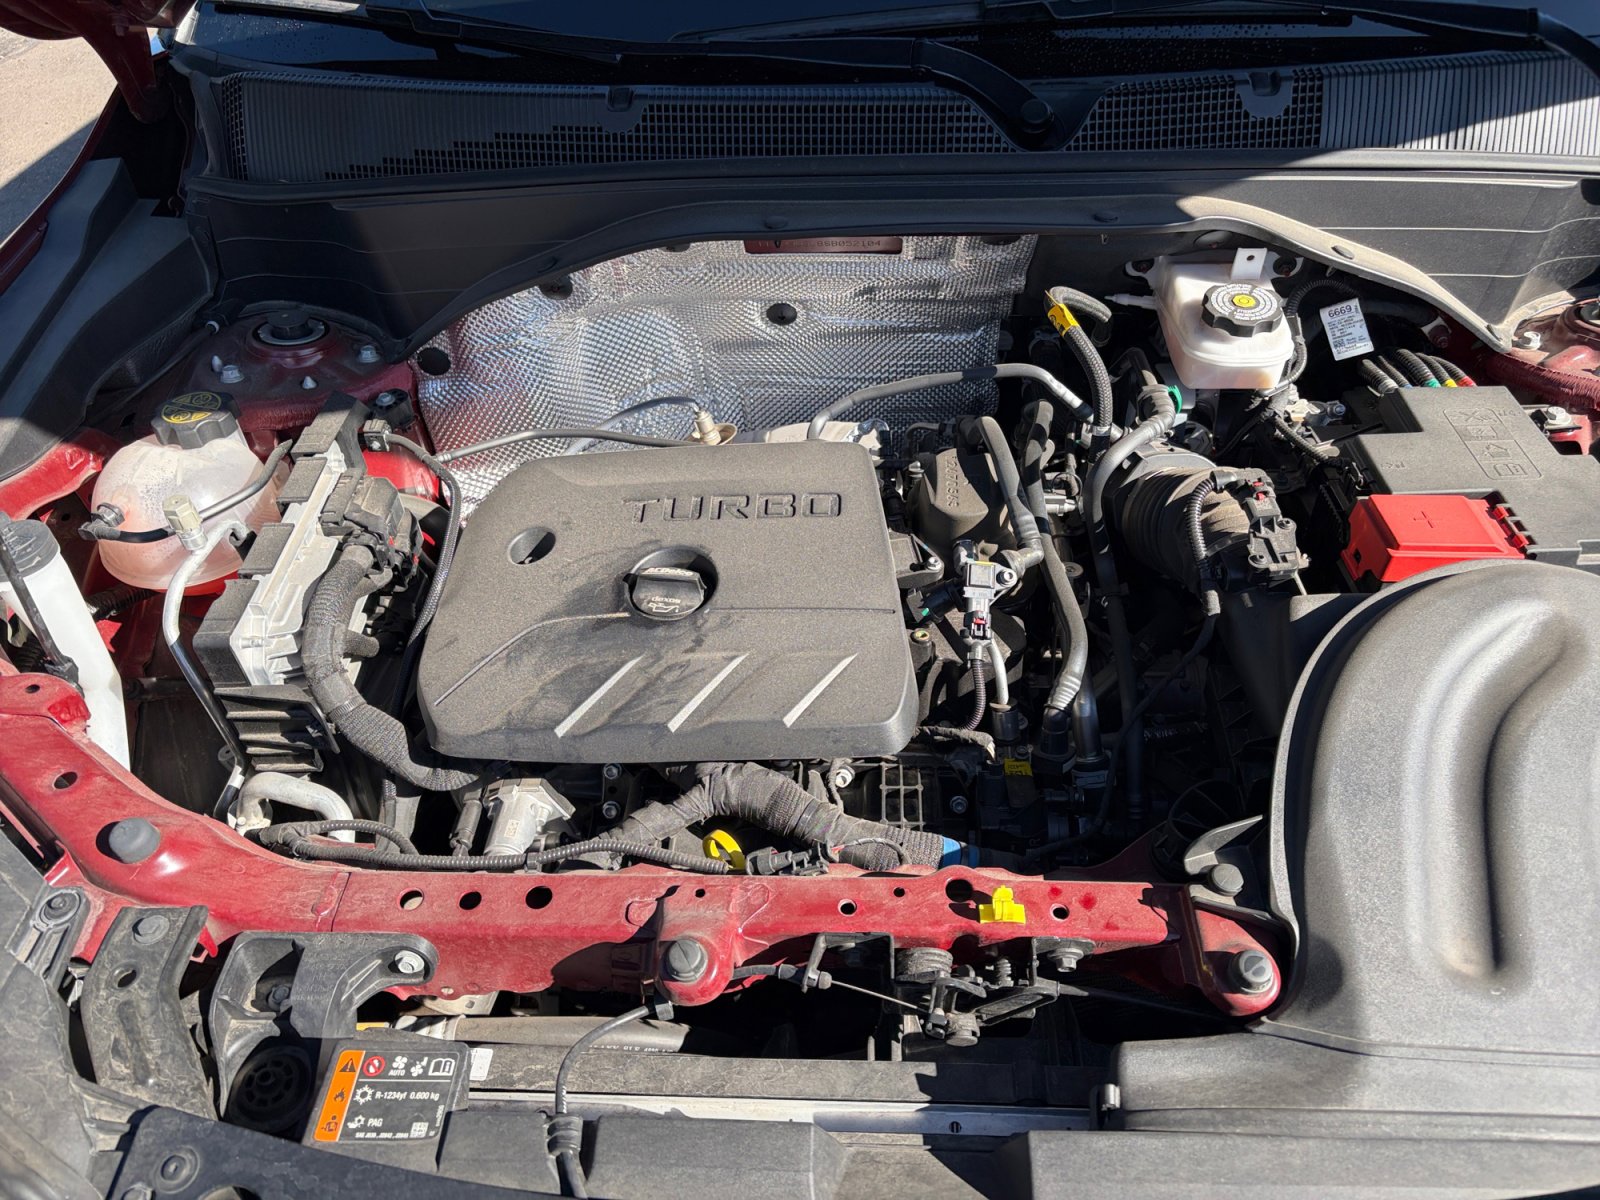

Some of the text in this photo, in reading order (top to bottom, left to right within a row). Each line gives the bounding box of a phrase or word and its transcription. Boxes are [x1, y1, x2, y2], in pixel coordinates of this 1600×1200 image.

[1328, 304, 1352, 318] 6669
[622, 493, 842, 524] TURBO
[375, 1091, 440, 1102] R-1234yf 0.600 kg
[367, 1118, 383, 1127] PAG
